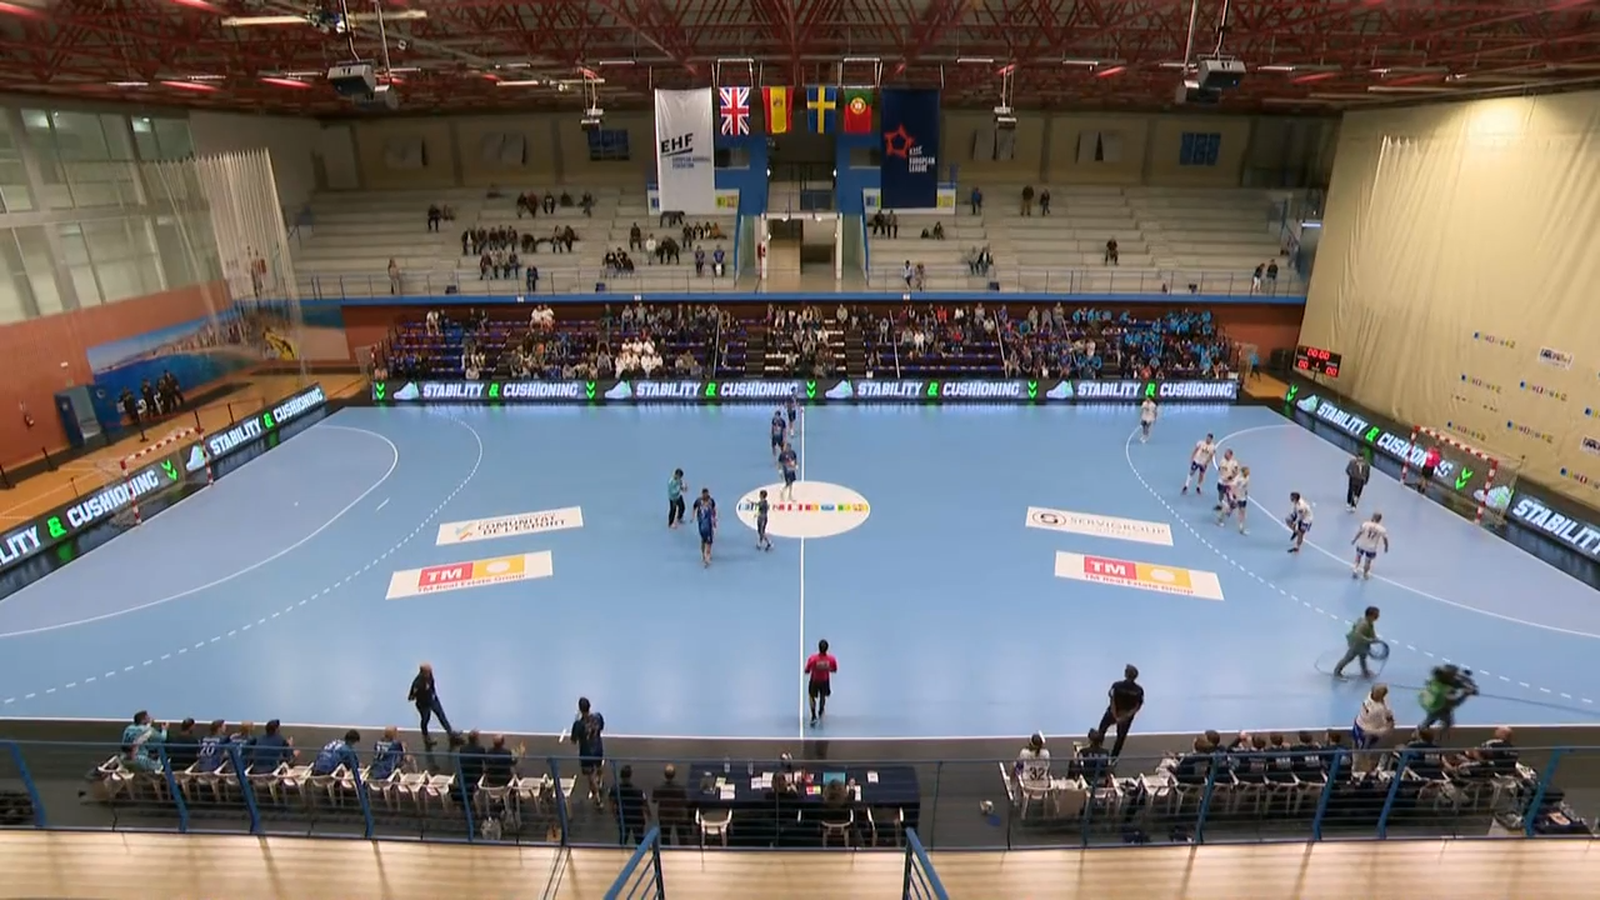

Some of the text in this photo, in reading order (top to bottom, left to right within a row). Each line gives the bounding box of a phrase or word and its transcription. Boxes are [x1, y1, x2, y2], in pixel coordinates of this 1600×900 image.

[661, 133, 693, 153] EHF
[423, 382, 578, 397] STABILITY & CUSHIONING
[636, 382, 700, 397] STABILITY
[705, 382, 716, 396] &
[857, 382, 1019, 397] STABILITY & CUSHIONING
[1078, 381, 1233, 397] STABILITY & CUSHIONING
[210, 387, 323, 455] STABILITY & CUSHIONING
[1316, 401, 1368, 435] STABILITY
[1365, 426, 1379, 442] &
[477, 515, 556, 531] COMUNITAT
[1070, 516, 1166, 534] SERVIGROUP
[0, 525, 41, 566] LITY
[47, 516, 67, 538] &
[427, 567, 463, 582] TM
[1090, 560, 1126, 576] TM
[1029, 766, 1045, 780] 32
